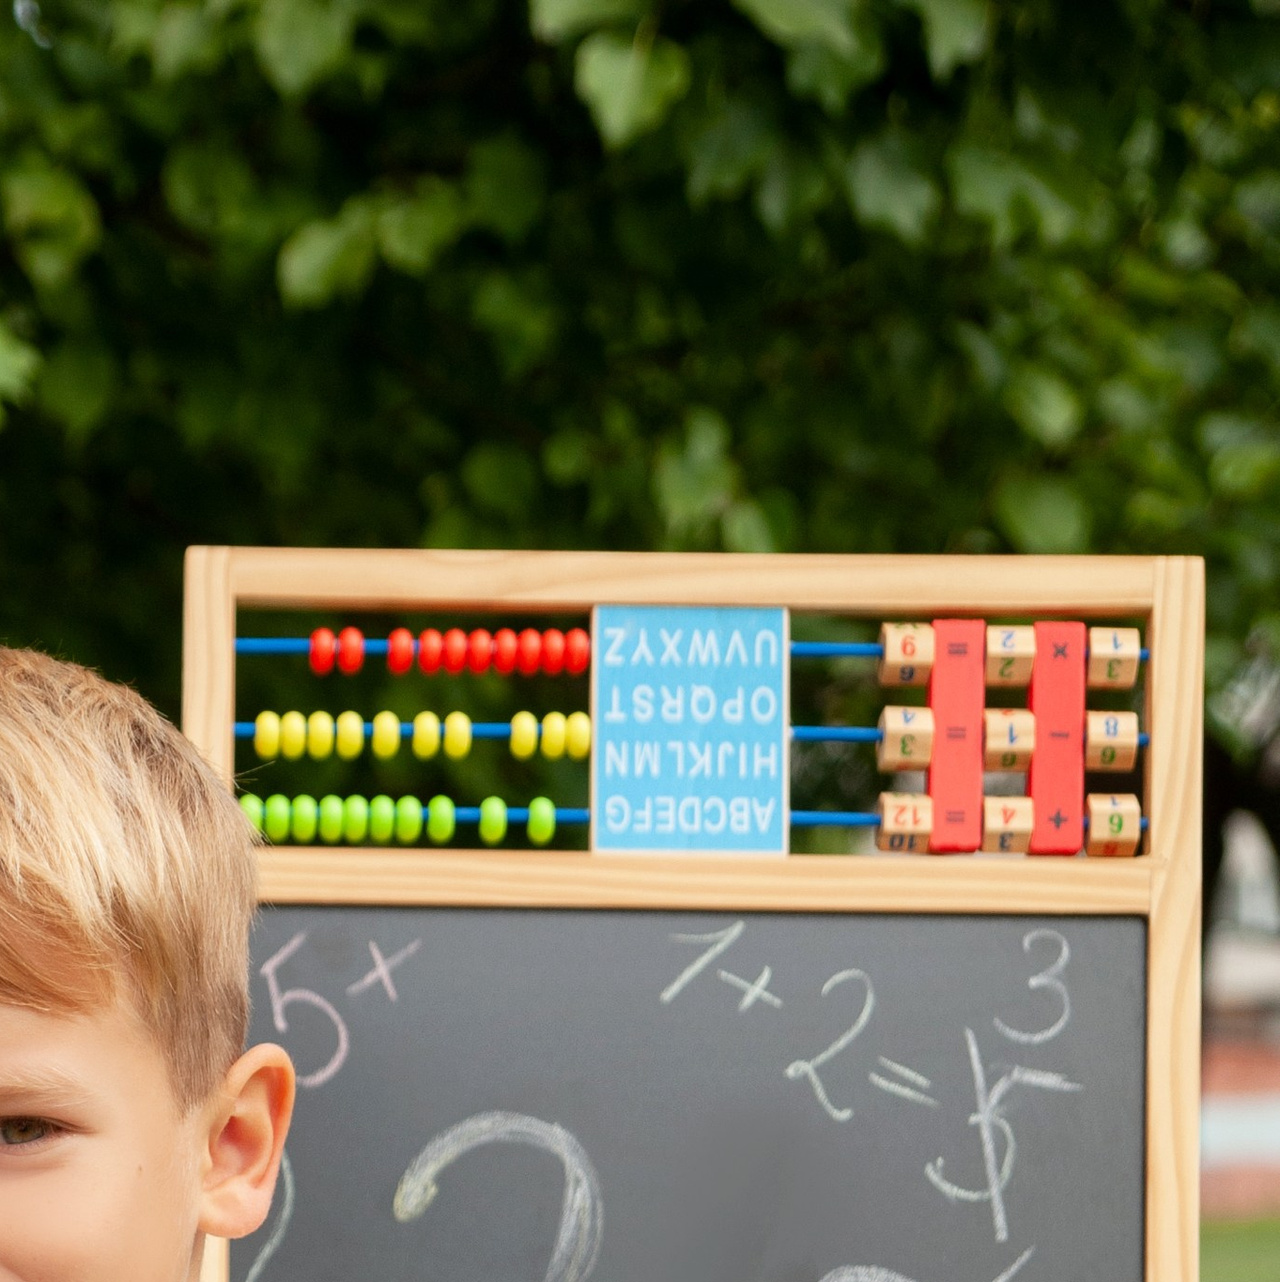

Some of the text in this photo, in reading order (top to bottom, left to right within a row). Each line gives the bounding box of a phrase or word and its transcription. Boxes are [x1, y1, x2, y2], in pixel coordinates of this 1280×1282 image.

[604, 627, 778, 667] UVWXYZ
[604, 684, 778, 724] OPQRST
[604, 740, 778, 779] HIJKLMN
[605, 794, 776, 834] ABCDEFG
